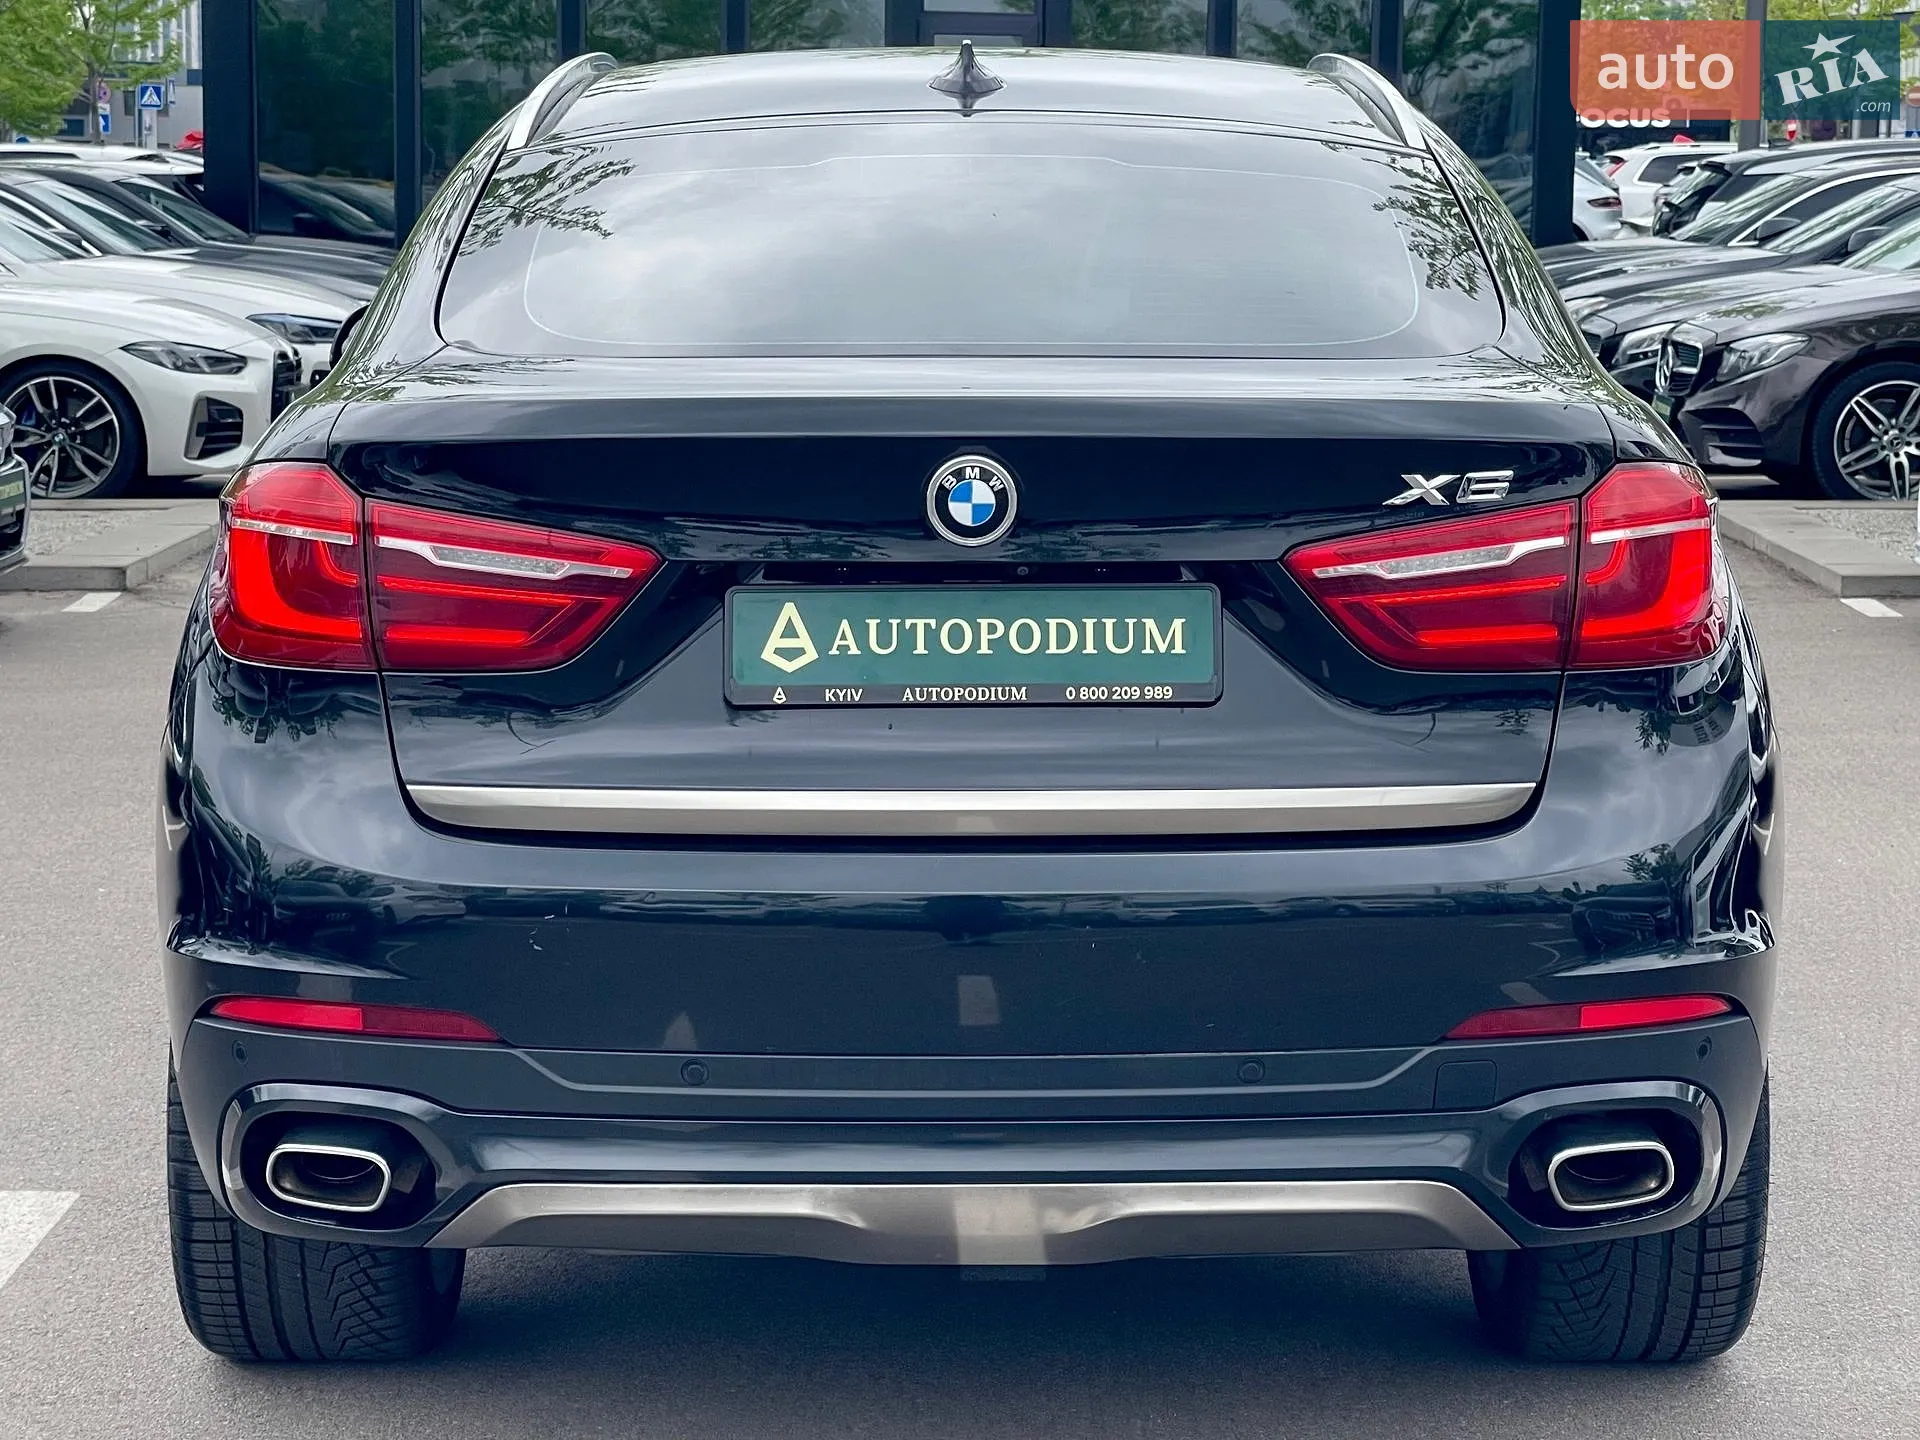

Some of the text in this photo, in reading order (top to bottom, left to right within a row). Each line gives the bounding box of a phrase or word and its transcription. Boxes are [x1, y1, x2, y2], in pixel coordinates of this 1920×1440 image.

[941, 466, 1005, 491] BMW
[1382, 470, 1514, 505] X6
[828, 617, 1187, 656] AUTOPODIUM
[824, 685, 1174, 702] KYIV AUTOPODIUM 0 800 209 989
